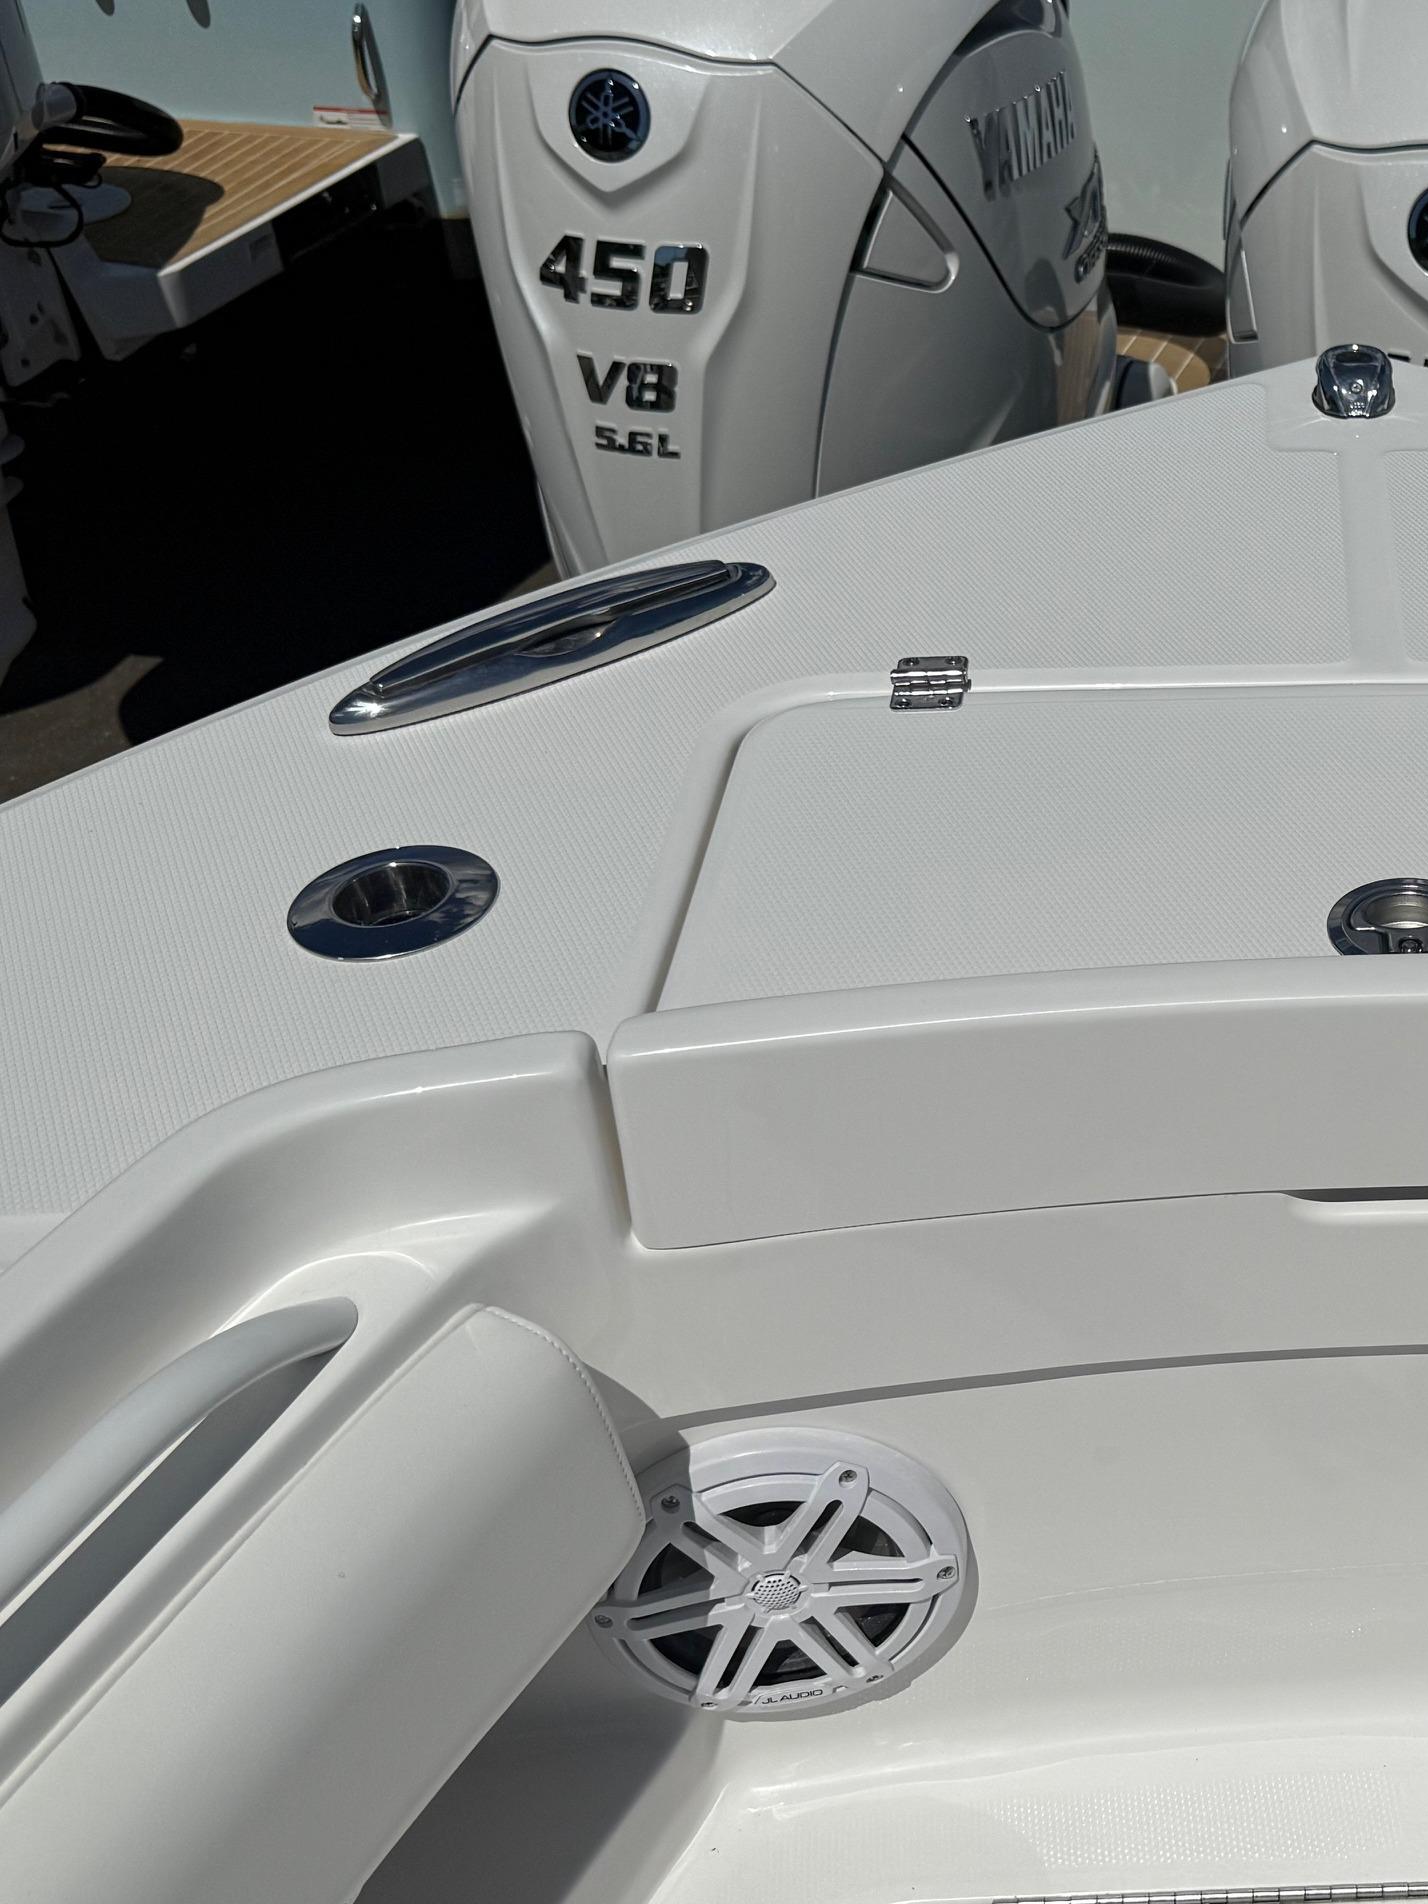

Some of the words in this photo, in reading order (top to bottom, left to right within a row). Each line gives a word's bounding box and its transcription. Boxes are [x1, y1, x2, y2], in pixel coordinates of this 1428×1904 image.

[540, 231, 709, 314] 450
[577, 351, 677, 413] V8
[780, 1689, 823, 1701] AUDIO
